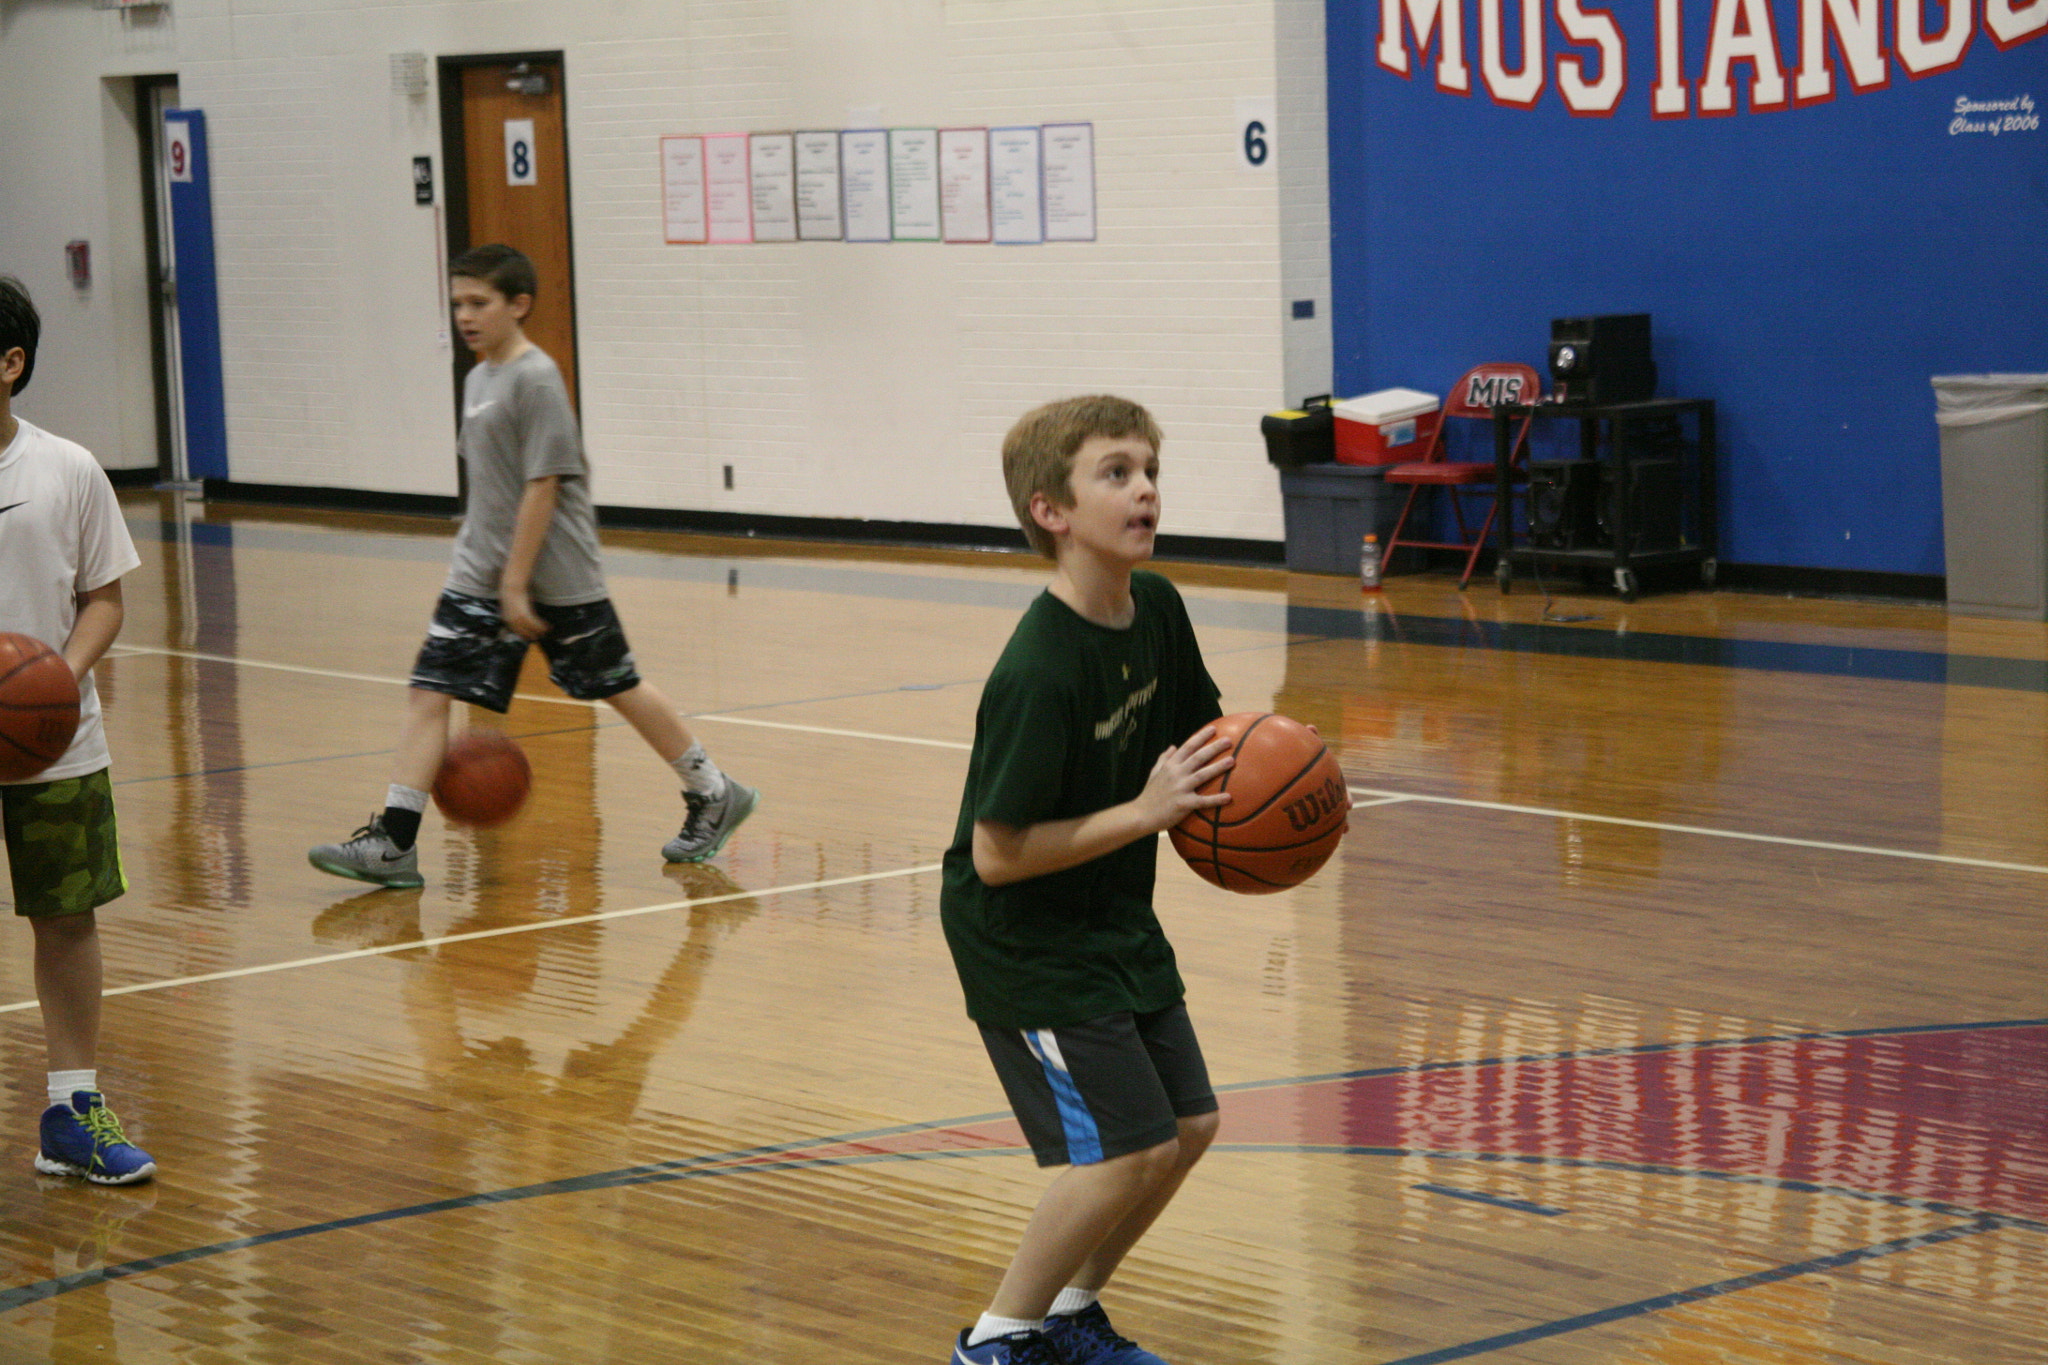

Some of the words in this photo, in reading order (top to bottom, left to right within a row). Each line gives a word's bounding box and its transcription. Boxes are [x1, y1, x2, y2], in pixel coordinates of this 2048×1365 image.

[1954, 96, 2020, 116] Sponsored
[2020, 94, 2035, 114] by
[1244, 120, 1268, 166] 6
[1948, 117, 1986, 135] Class
[1987, 118, 2002, 136] of
[2003, 115, 2040, 131] 2006
[171, 140, 185, 176] 9
[512, 140, 530, 178] 8
[1465, 373, 1524, 407] MIS
